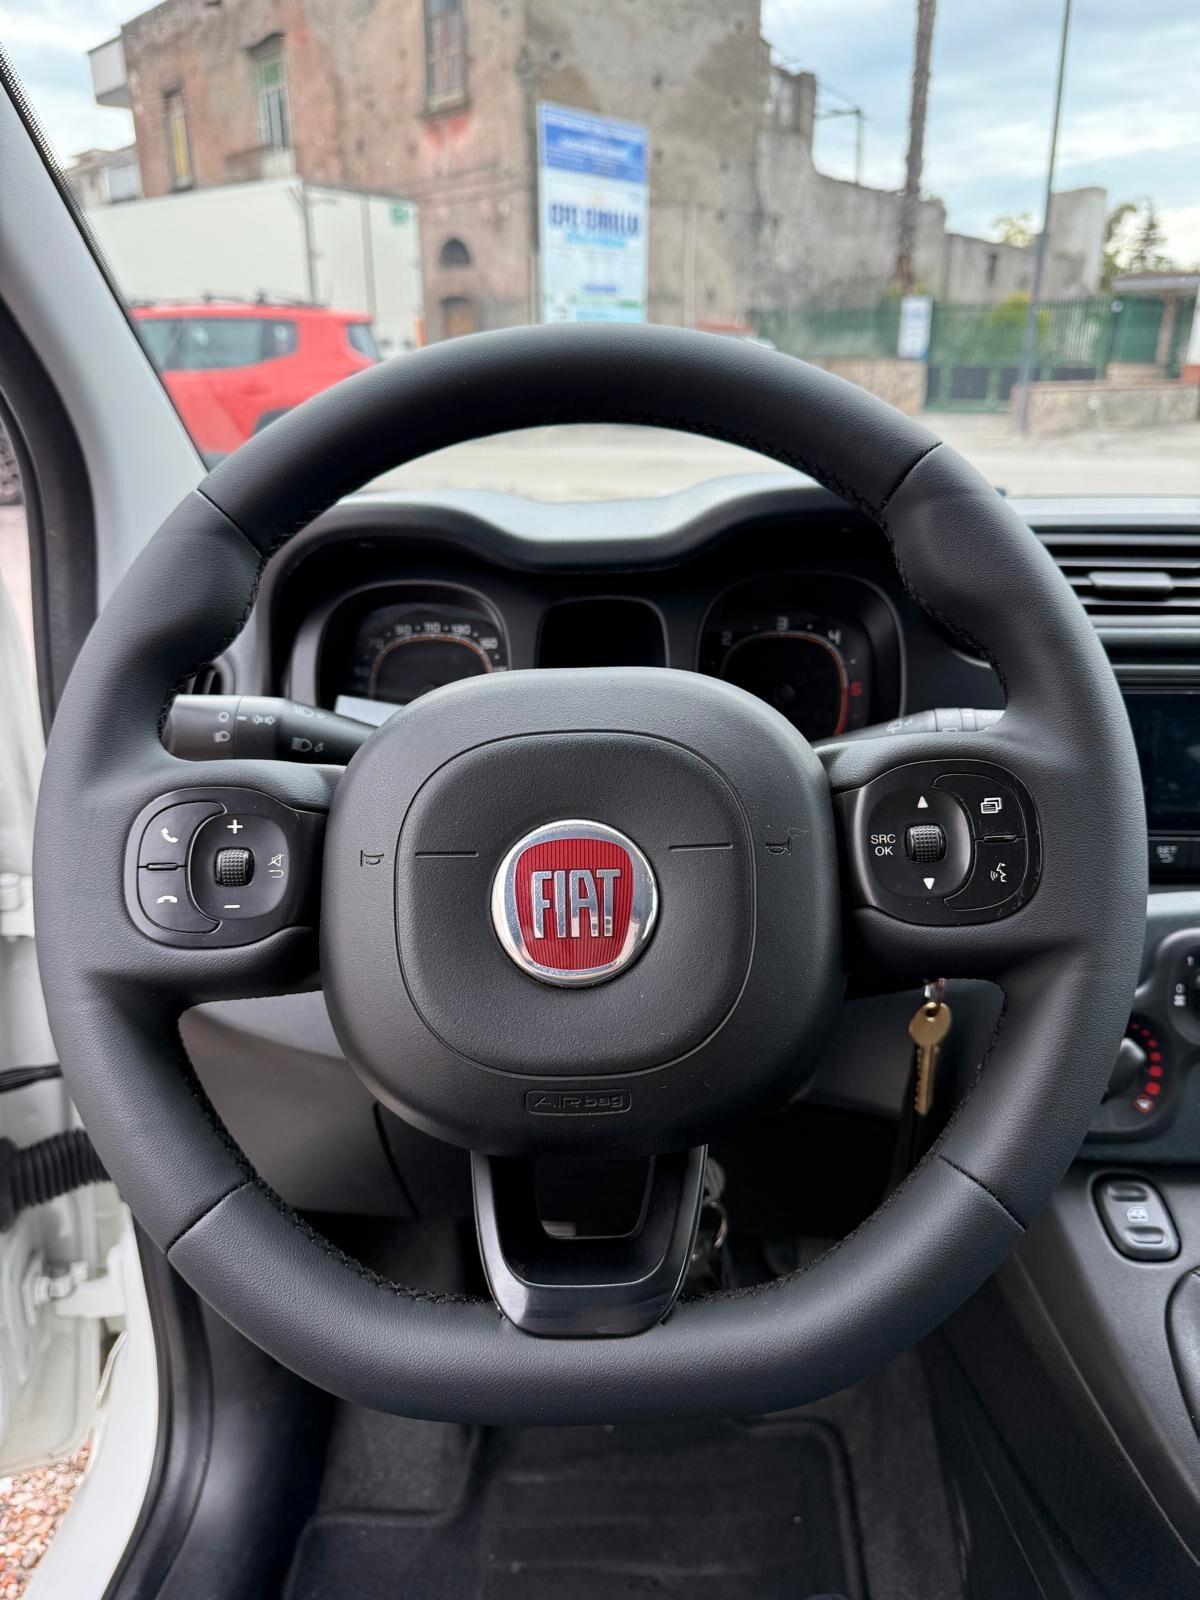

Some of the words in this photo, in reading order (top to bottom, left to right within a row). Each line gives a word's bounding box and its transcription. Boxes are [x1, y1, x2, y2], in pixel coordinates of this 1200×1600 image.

[828, 630, 841, 644] 4
[870, 834, 896, 845] SRC
[874, 846, 893, 856] OK
[531, 869, 621, 939] FIAT
